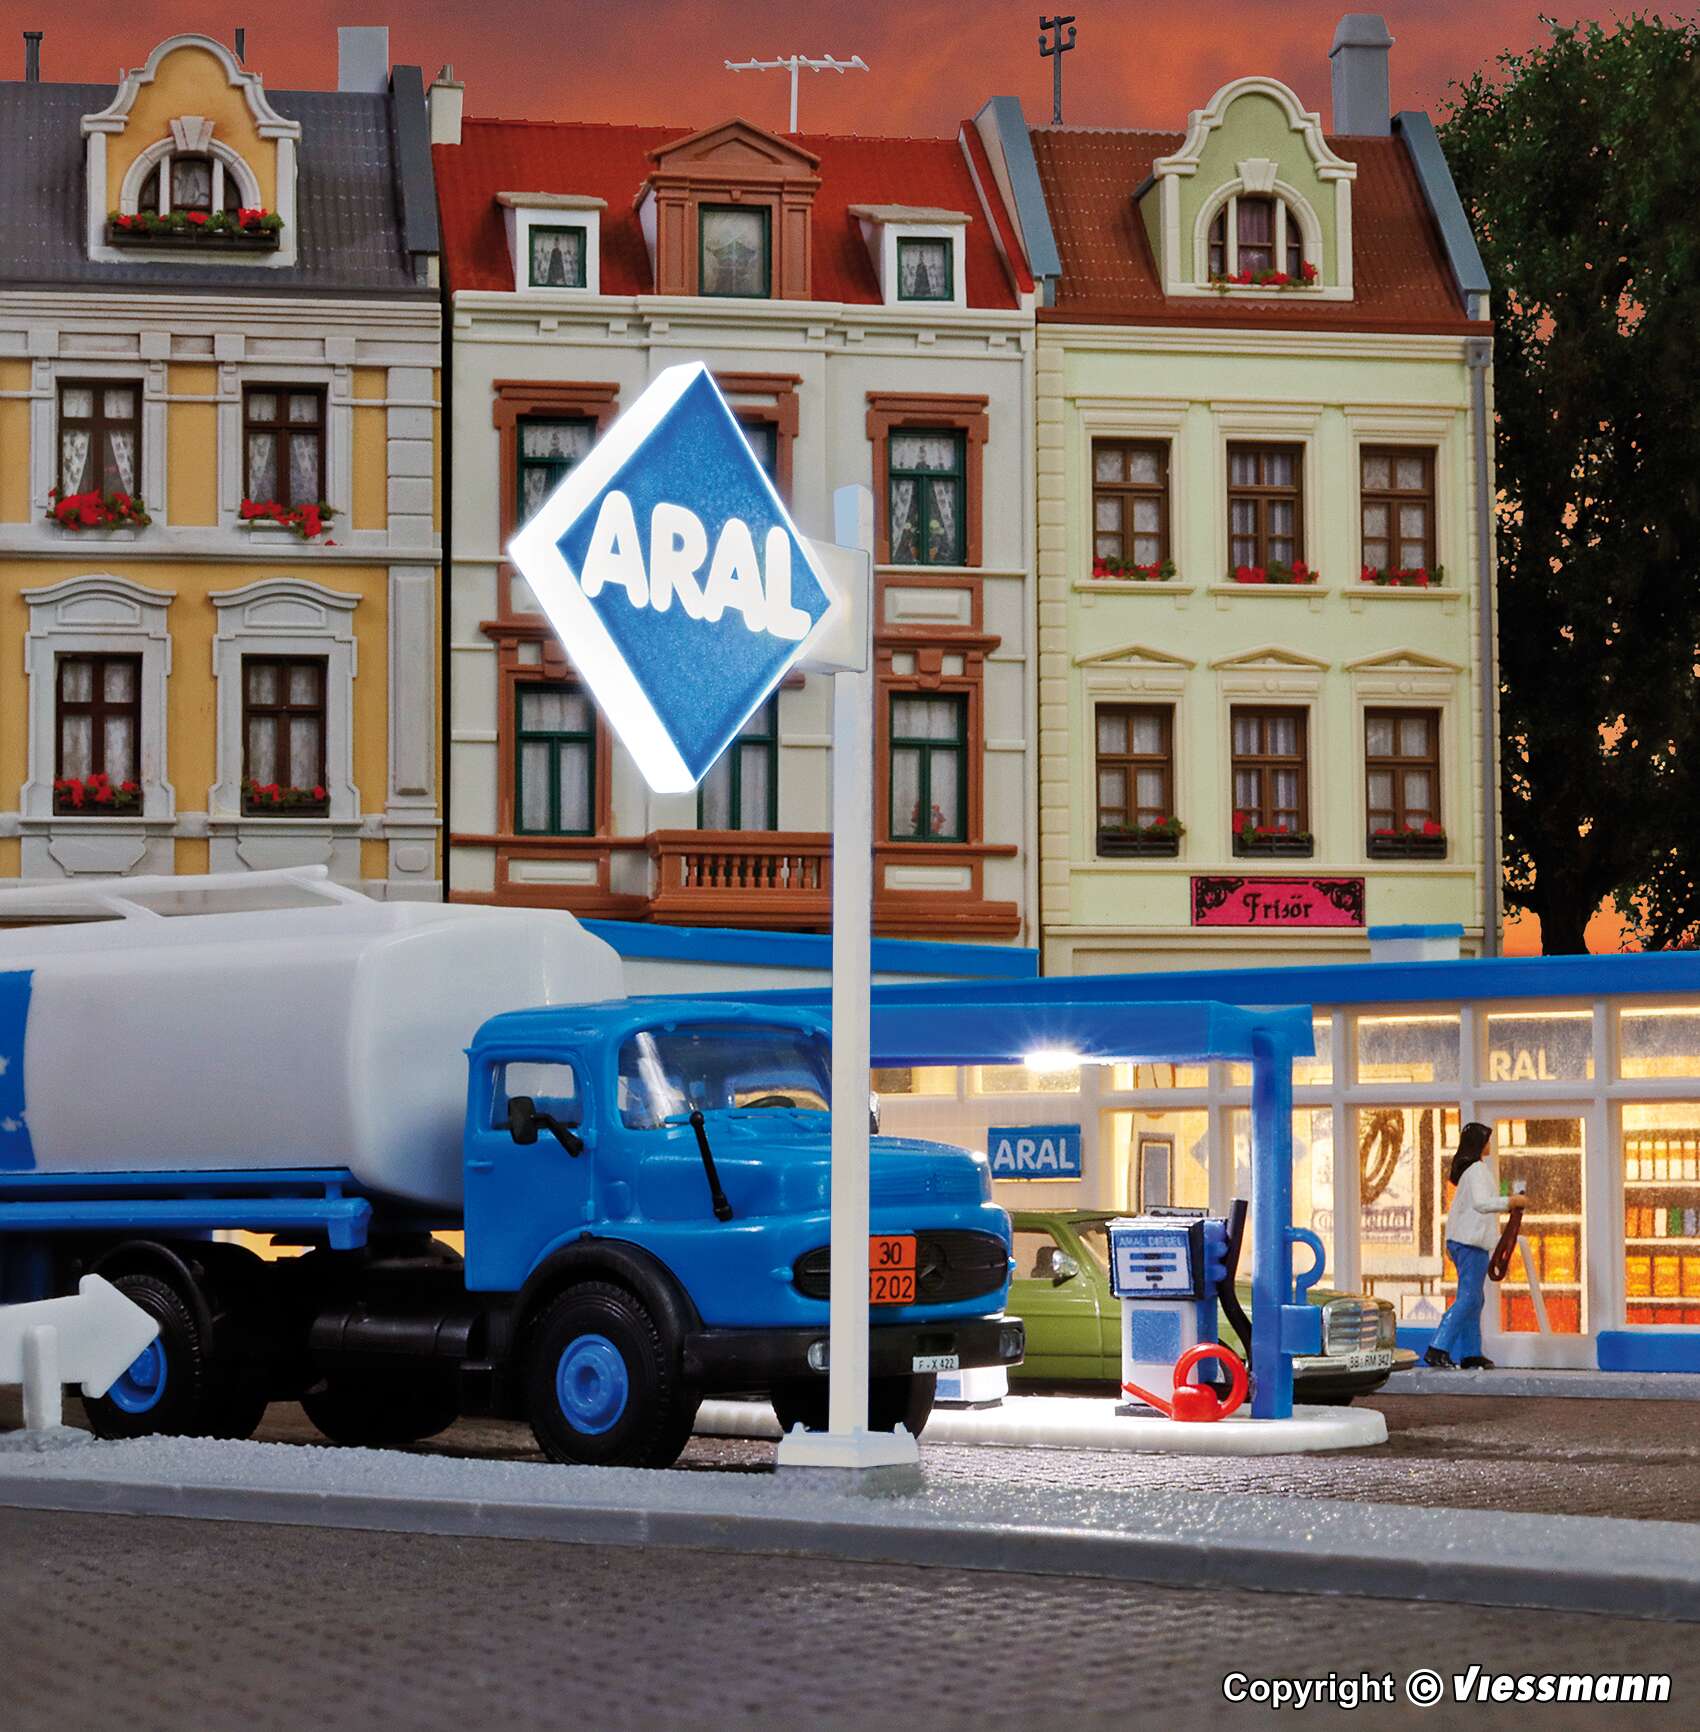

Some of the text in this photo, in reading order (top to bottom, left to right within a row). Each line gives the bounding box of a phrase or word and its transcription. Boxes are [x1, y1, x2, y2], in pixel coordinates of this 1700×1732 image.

[580, 490, 813, 640] ARAL
[1243, 893, 1312, 922] Frisör
[993, 1138, 1075, 1170] ARAL
[879, 1241, 902, 1265] 30
[1148, 1236, 1183, 1247] DIESEL
